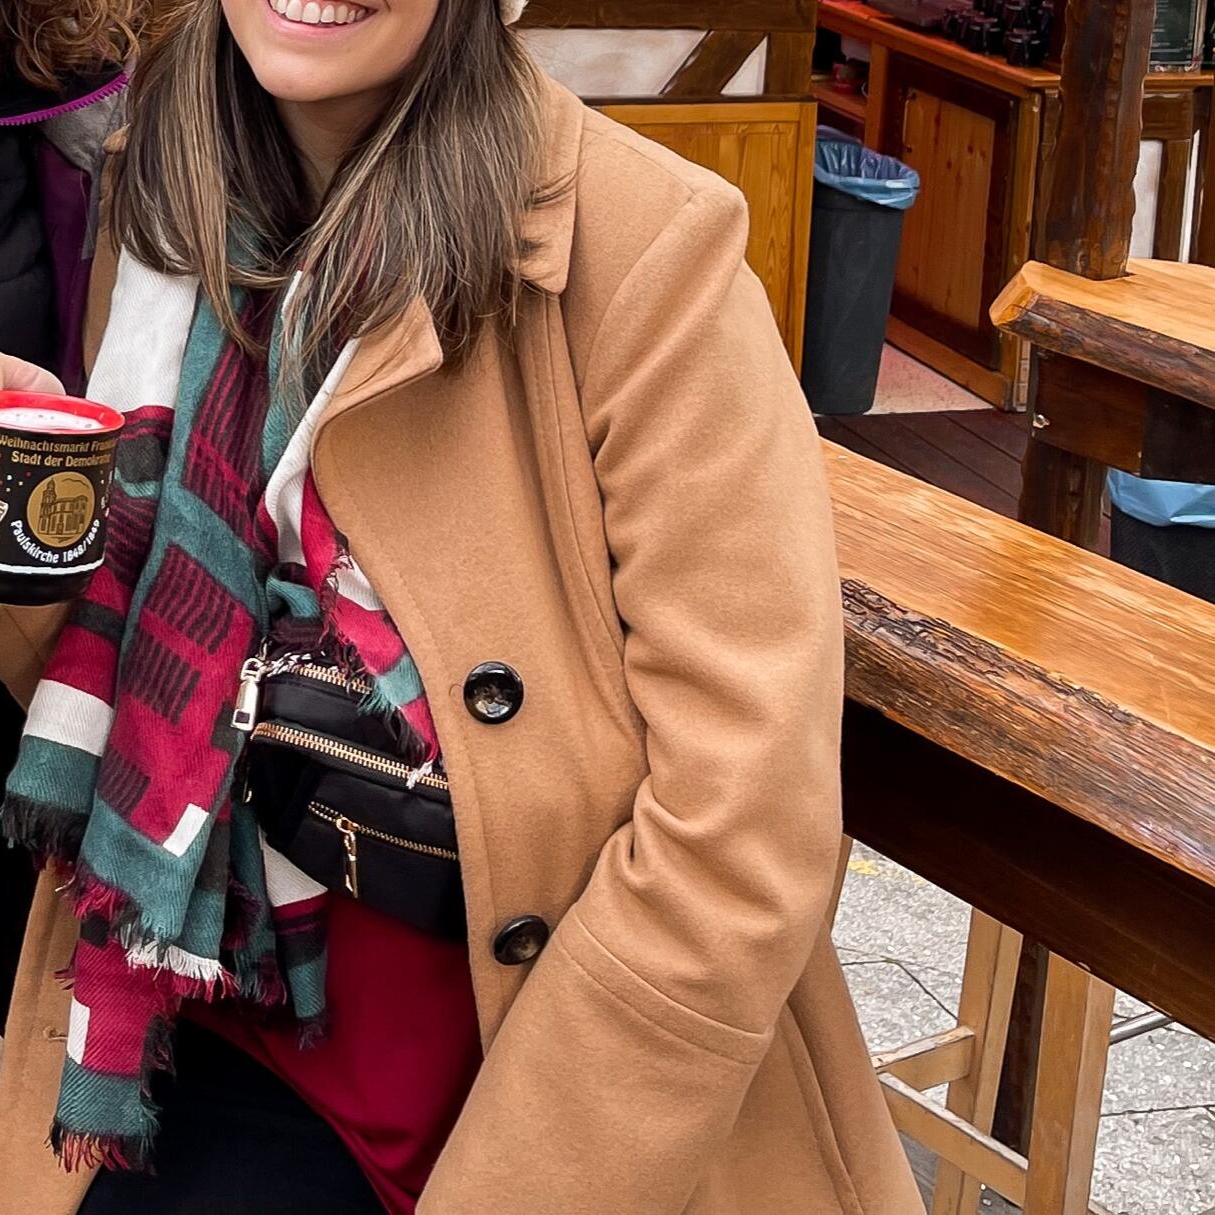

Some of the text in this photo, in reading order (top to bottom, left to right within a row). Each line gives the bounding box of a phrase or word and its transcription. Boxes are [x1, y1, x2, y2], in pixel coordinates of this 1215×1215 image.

[11, 451, 41, 465] Stadt
[44, 455, 63, 467] der
[10, 520, 59, 563] Paulskirche
